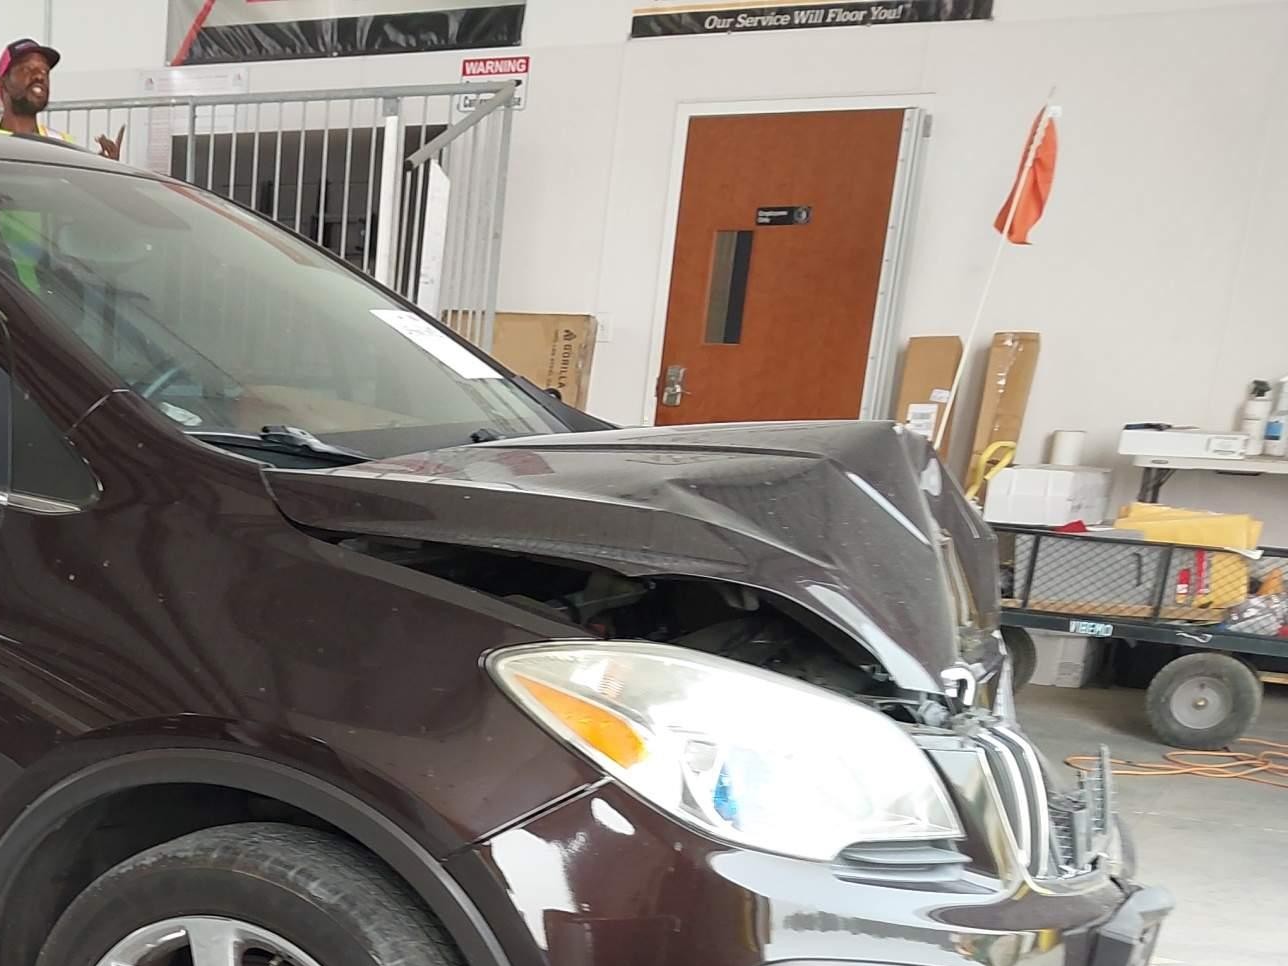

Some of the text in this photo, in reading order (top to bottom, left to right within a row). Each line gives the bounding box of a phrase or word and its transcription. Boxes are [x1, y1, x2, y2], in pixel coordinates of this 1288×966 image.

[704, 4, 904, 29] Our Service Will Floor You!
[464, 58, 527, 75] WARNING
[558, 344, 573, 389] GORILLA
